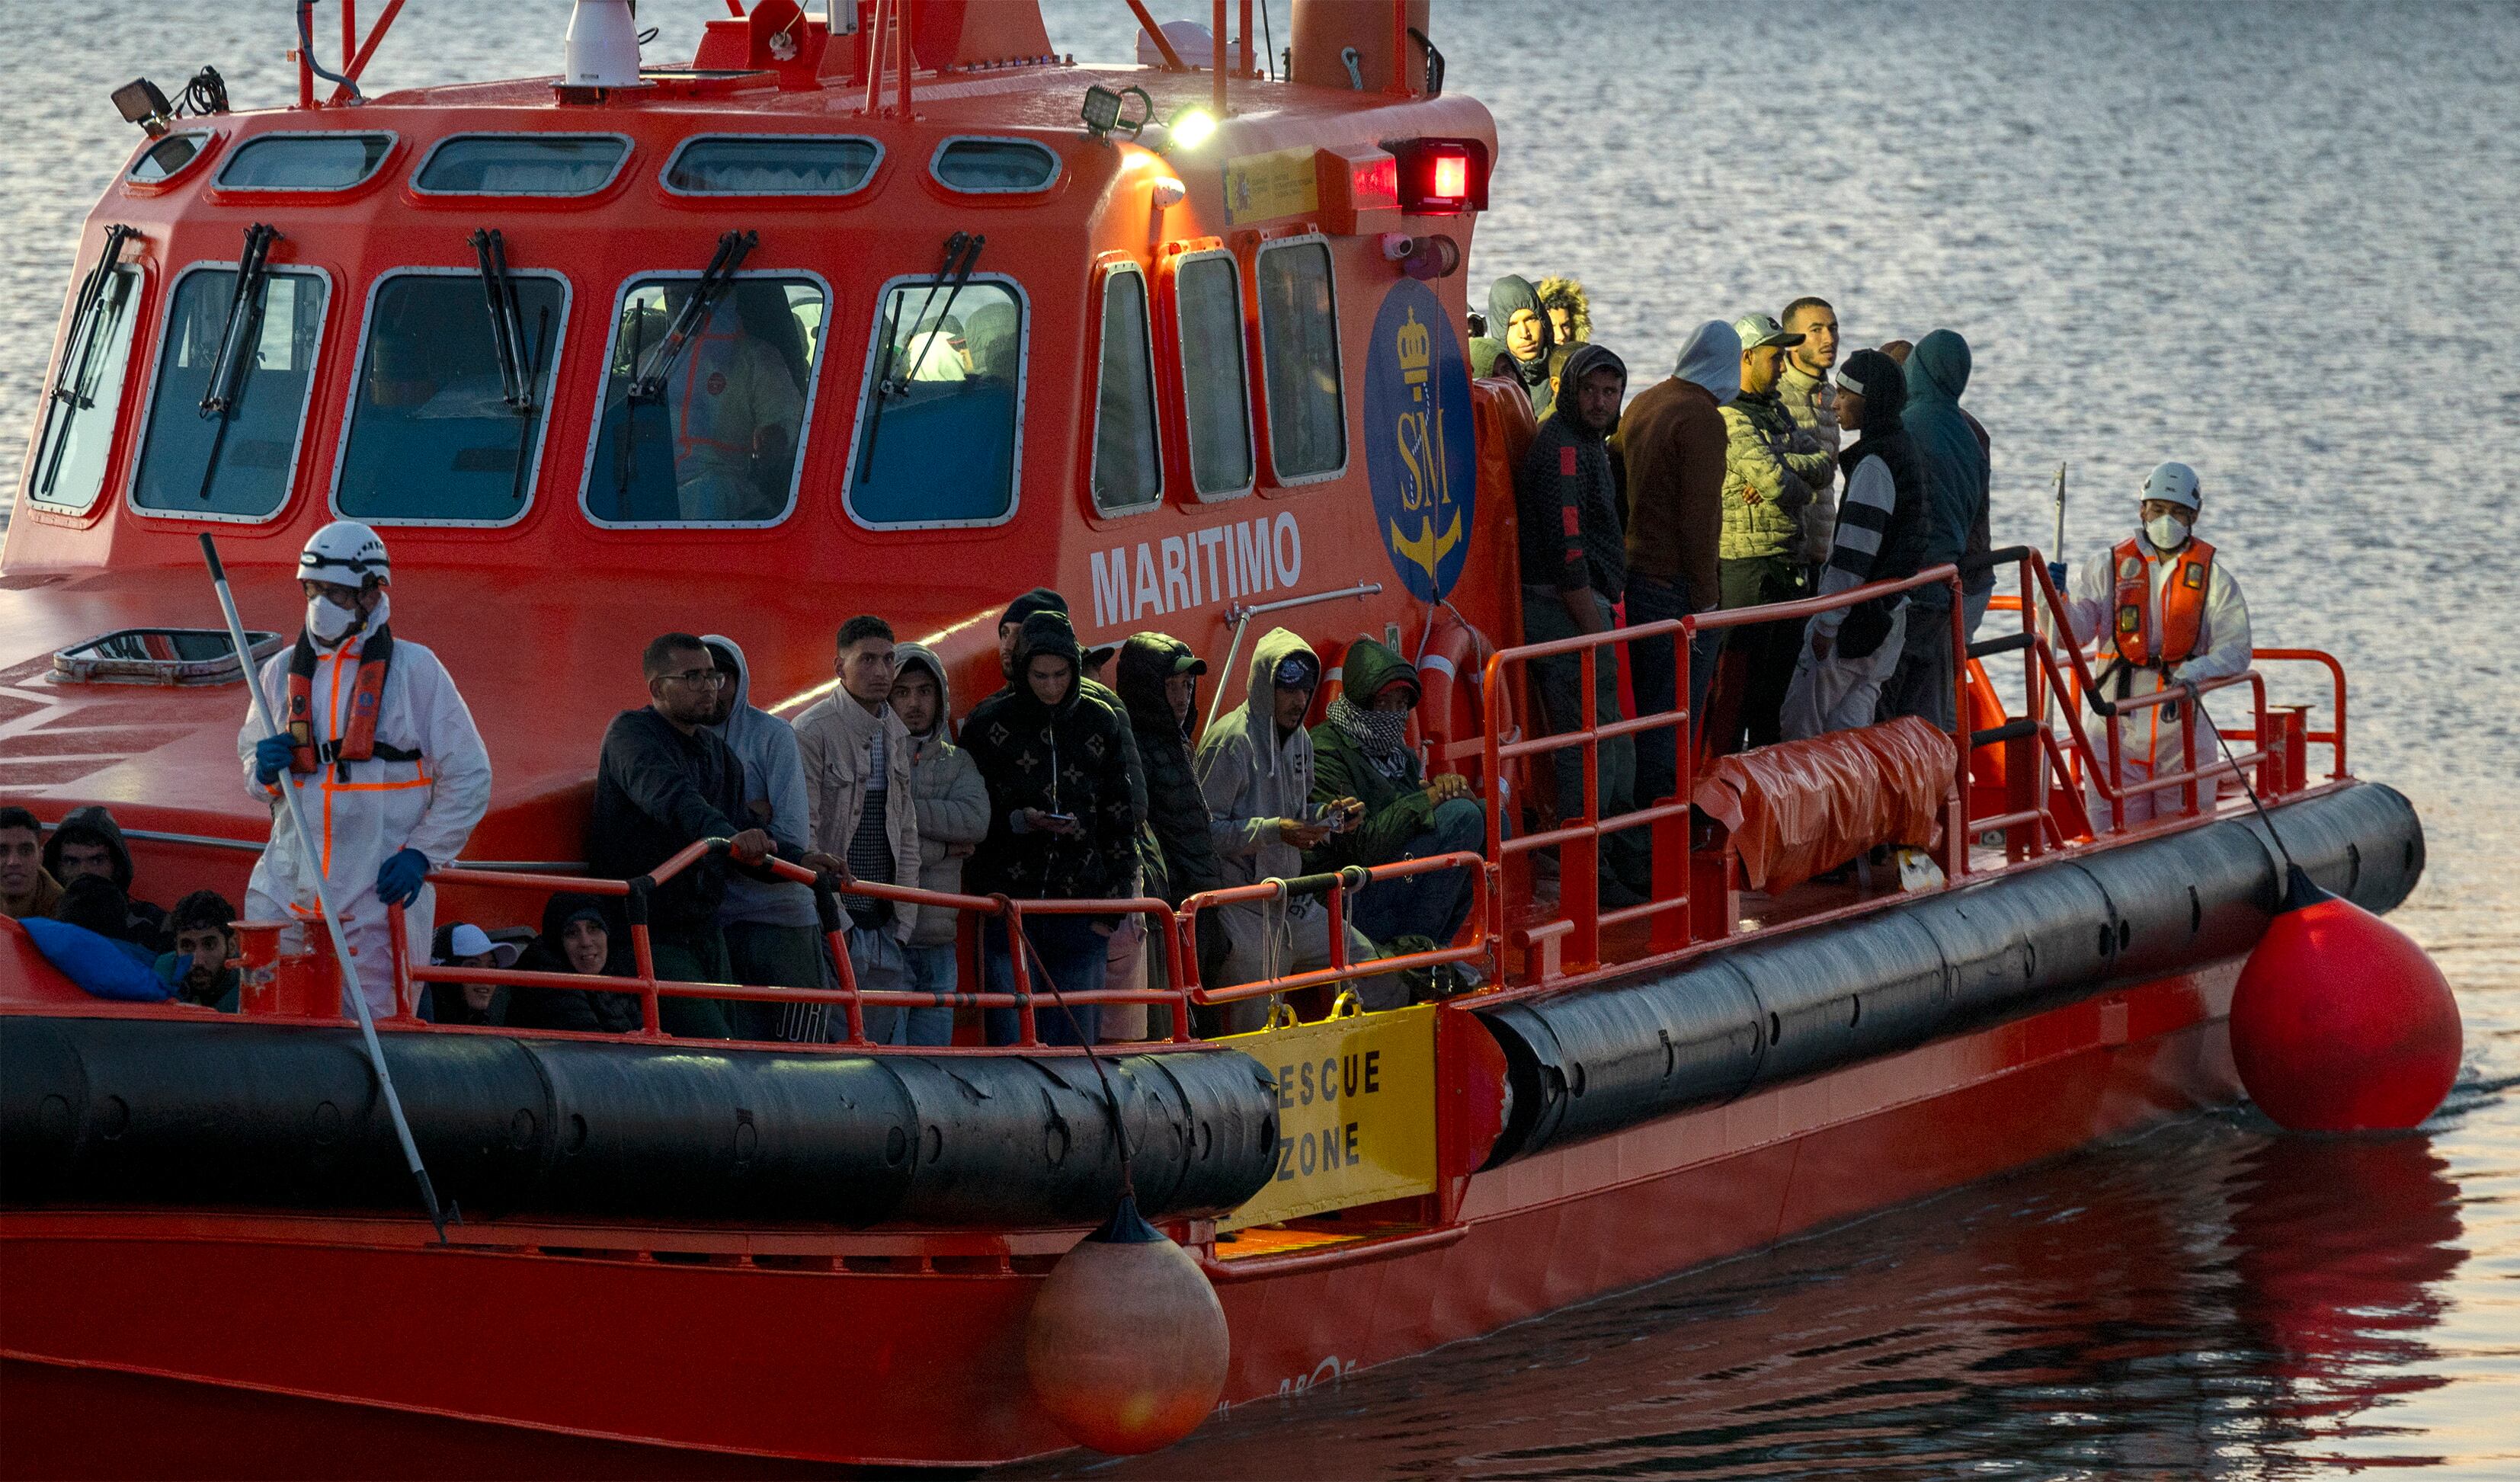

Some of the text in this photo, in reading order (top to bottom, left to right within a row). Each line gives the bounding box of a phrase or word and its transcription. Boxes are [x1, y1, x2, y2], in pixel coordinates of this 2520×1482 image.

[1398, 408, 1451, 511] SM
[1090, 511, 1302, 628] MARITIMO
[775, 1003, 830, 1044] JOR
[1279, 1051, 1380, 1109] ESCUE
[1277, 1122, 1359, 1182] ZONE
